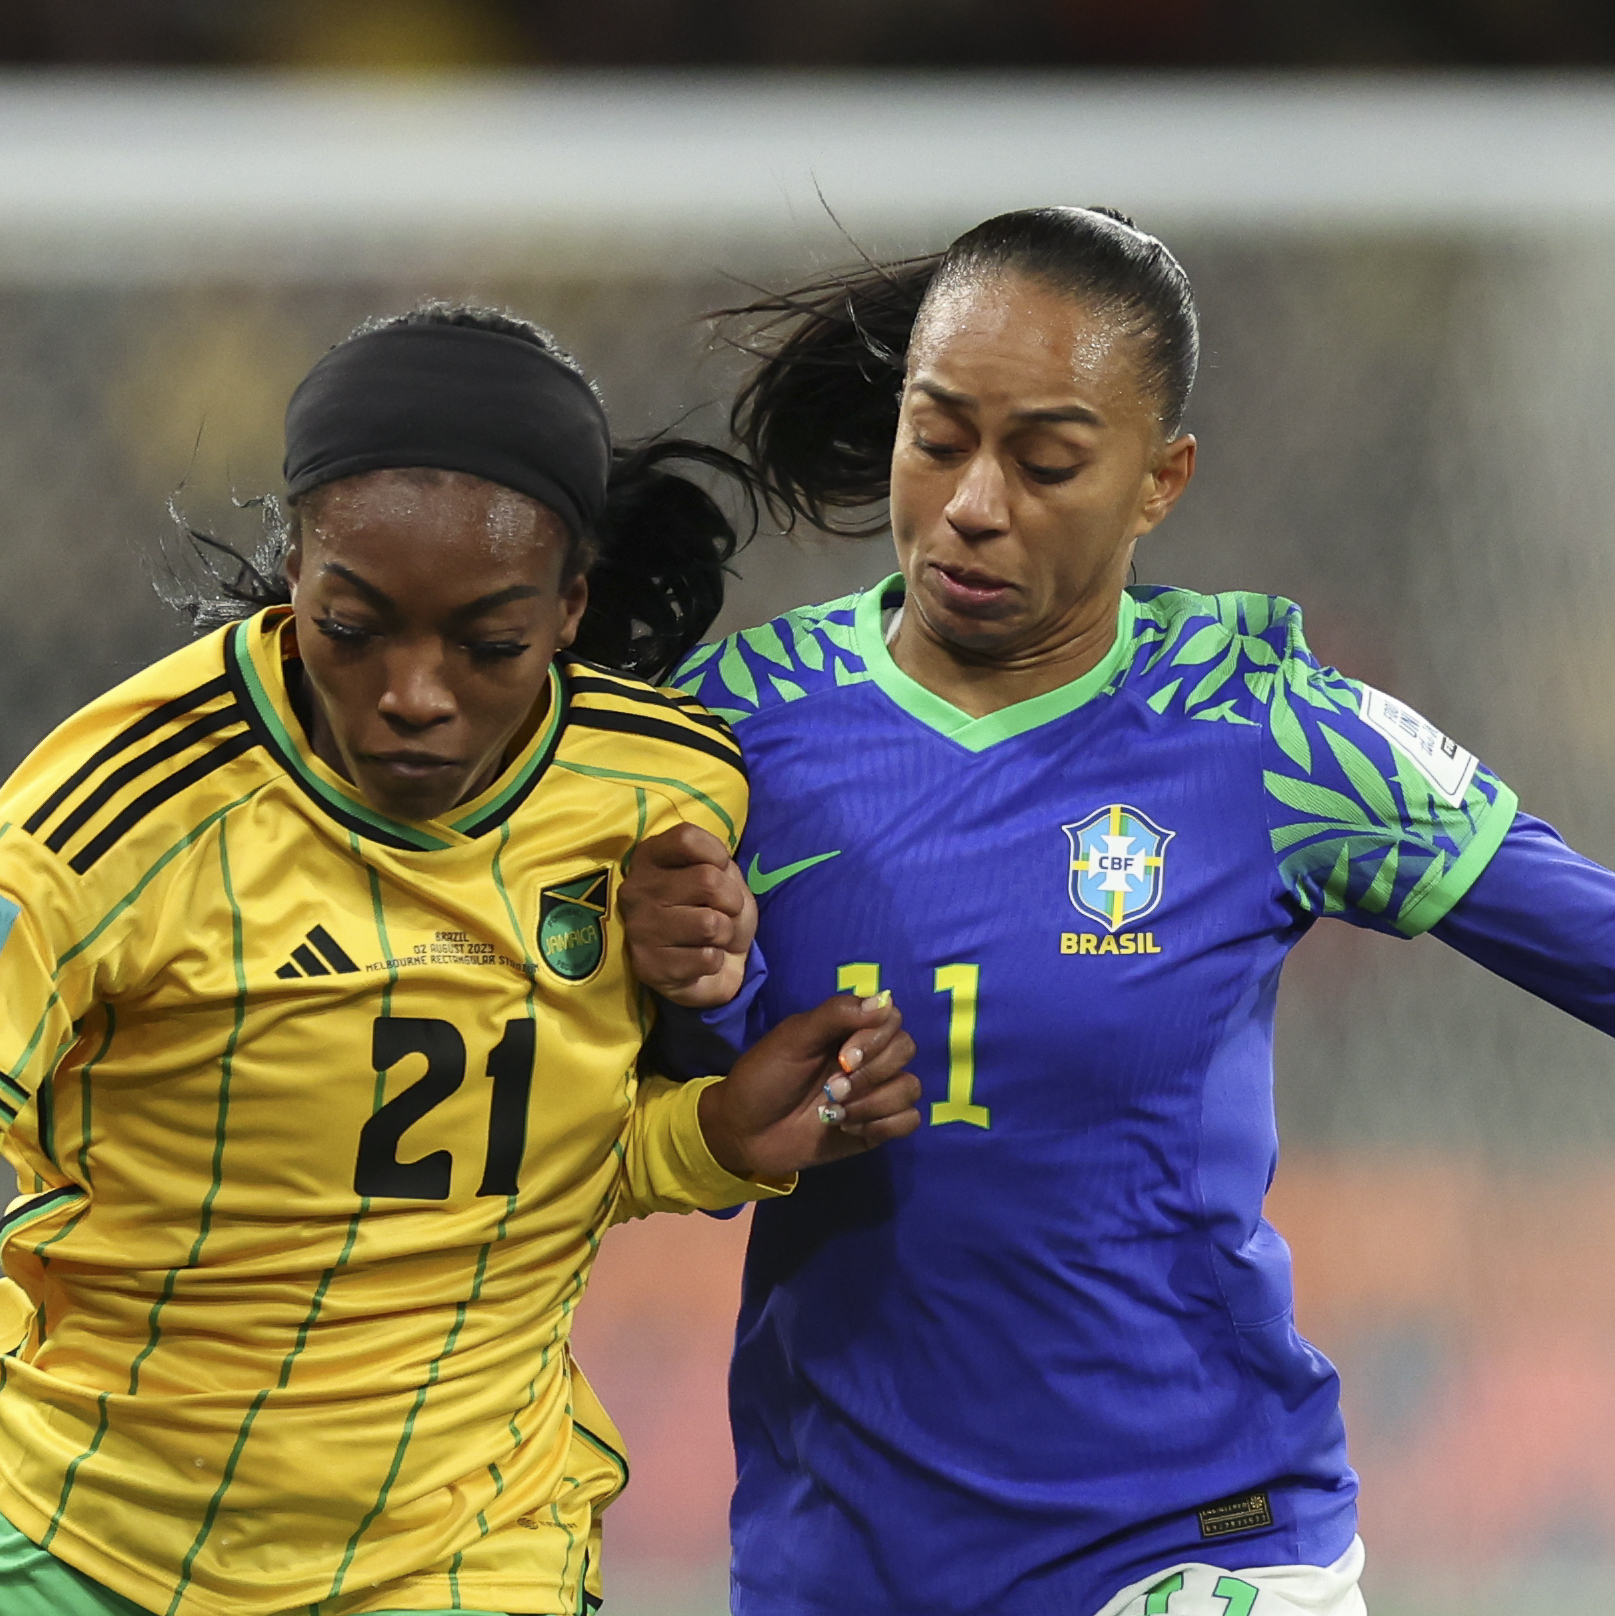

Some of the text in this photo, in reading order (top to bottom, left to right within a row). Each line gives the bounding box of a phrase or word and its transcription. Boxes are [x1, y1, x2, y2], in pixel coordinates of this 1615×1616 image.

[1098, 856, 1134, 872] CBF
[435, 932, 469, 942] BRAZIL
[1060, 932, 1162, 955] BRASIL
[413, 944, 494, 954] 02 AUGUST 2023
[365, 956, 427, 972] MELBOURNE
[354, 1017, 536, 1200] 21
